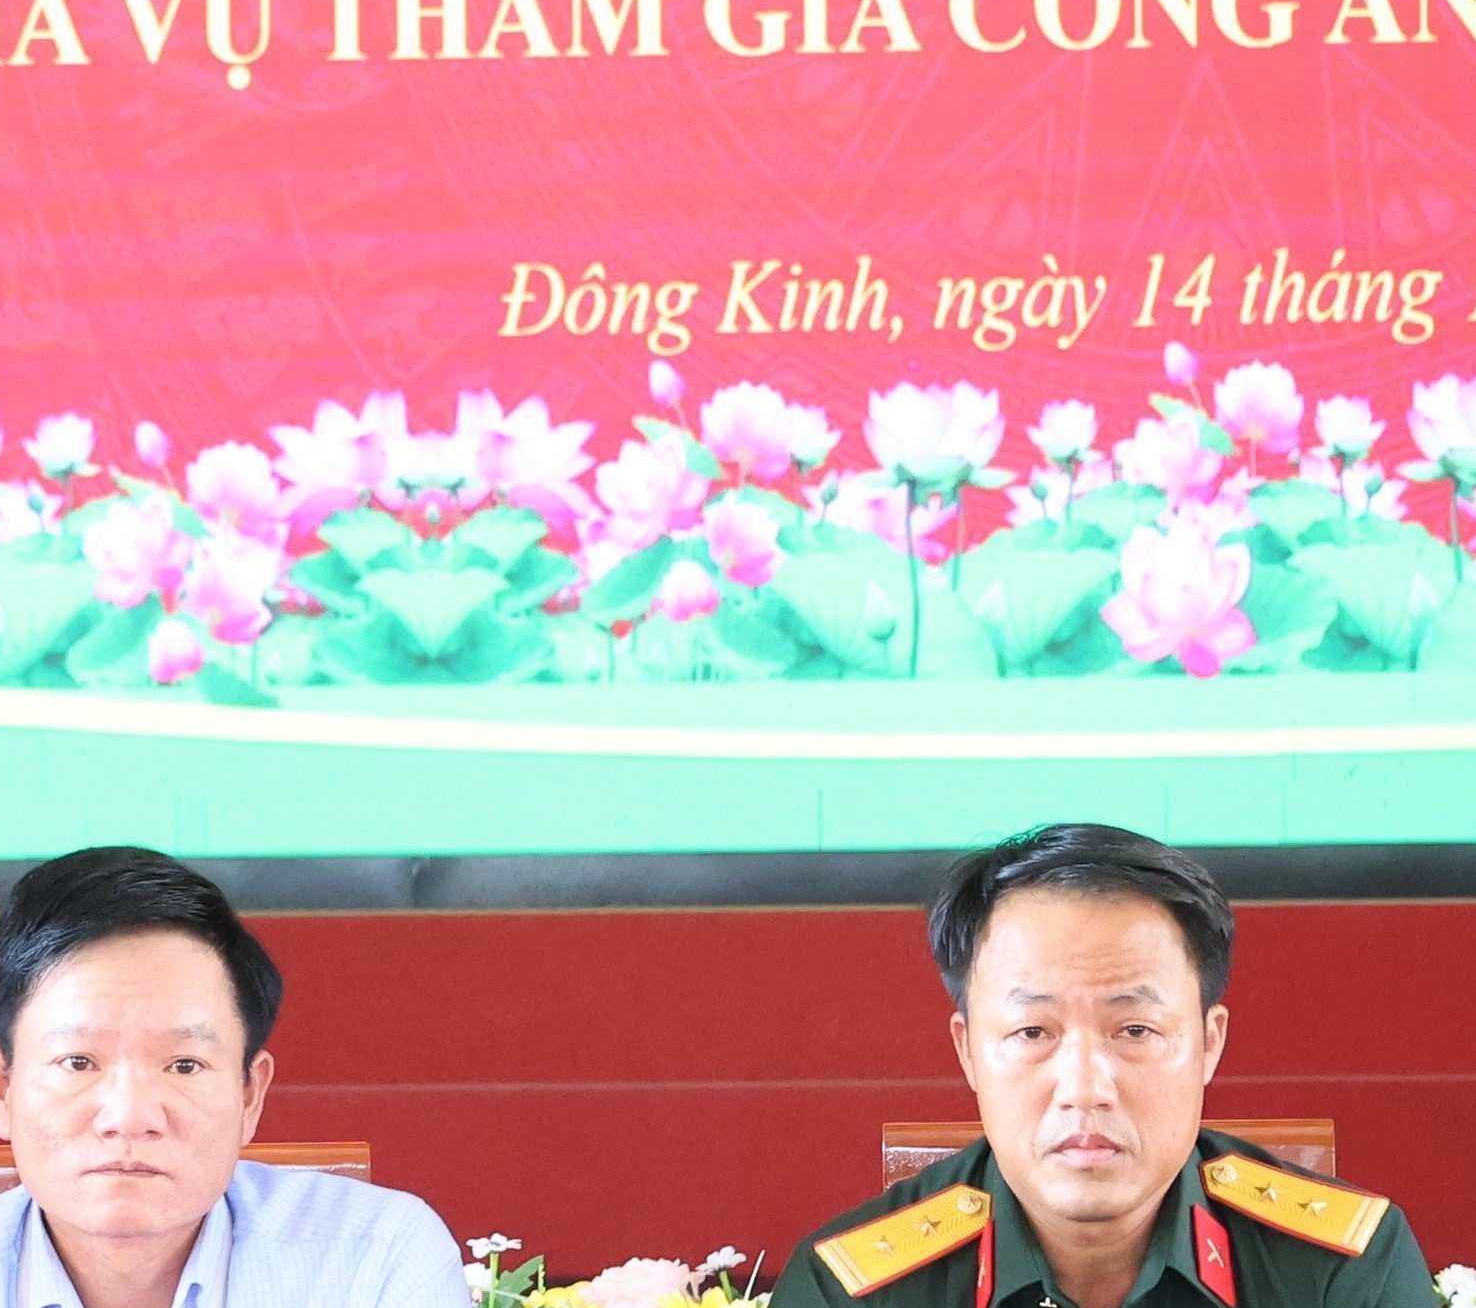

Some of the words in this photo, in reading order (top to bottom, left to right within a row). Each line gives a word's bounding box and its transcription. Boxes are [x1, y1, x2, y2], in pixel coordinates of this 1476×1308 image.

[499, 258, 698, 356] Đông
[717, 255, 903, 341] Kinh,
[934, 255, 1107, 351] ngày
[1133, 252, 1216, 328] 14
[1240, 248, 1443, 344] tháng
